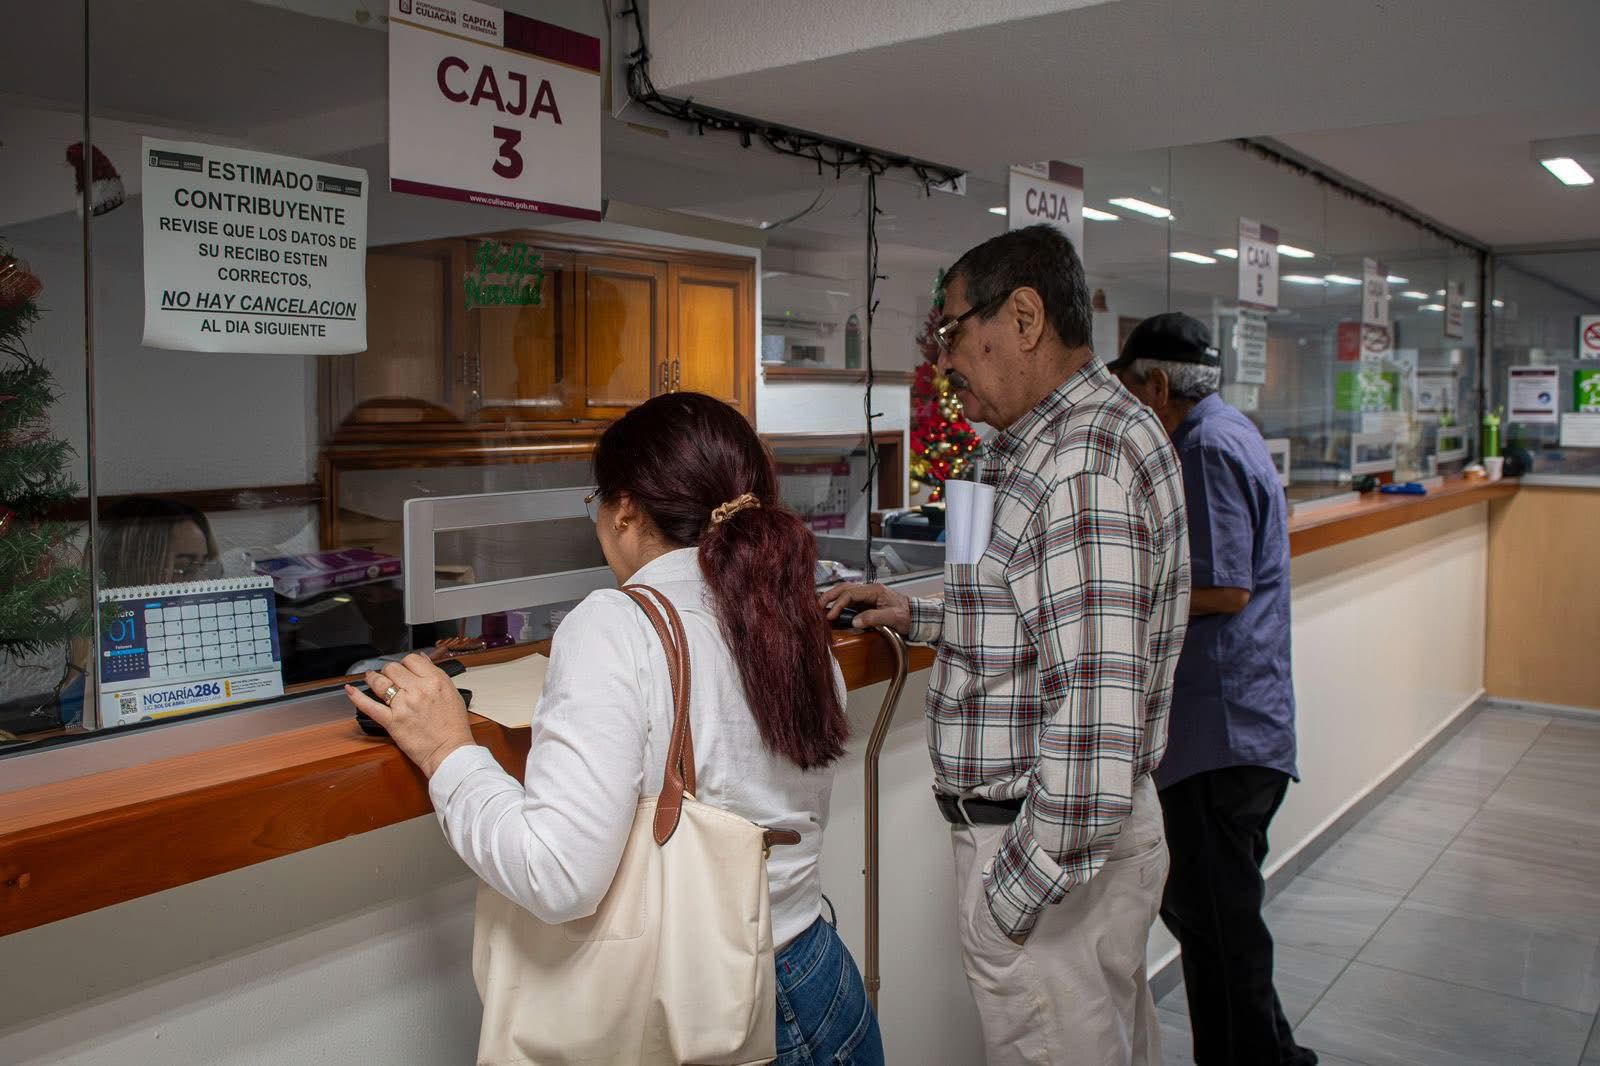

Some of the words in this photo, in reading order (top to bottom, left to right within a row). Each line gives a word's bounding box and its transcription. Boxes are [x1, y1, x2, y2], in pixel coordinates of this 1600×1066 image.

[463, 14, 497, 30] CAPITAL
[437, 56, 562, 125] CAJA
[492, 125, 523, 179] 3
[208, 160, 313, 191] ESTIMADO
[175, 188, 345, 225] CONTRIBUYENTE
[470, 195, 538, 211] www.culiacan.gob.mx
[1026, 187, 1070, 224] CAJA
[160, 217, 218, 235] REVISE
[223, 223, 254, 239] QUE
[259, 227, 287, 242] LOS
[291, 231, 336, 247] DATOS
[340, 236, 357, 250] DE
[198, 243, 219, 257] SU
[224, 245, 279, 263] RECIBO
[284, 251, 327, 267] ESTEN
[1248, 245, 1271, 270] CAJA
[218, 267, 312, 289] CORRECTOS,
[161, 290, 190, 308] NO
[196, 292, 236, 310] HAY
[240, 295, 357, 317] CANCELACION
[200, 319, 221, 333] AL
[225, 320, 250, 334] DIA
[254, 321, 326, 337] SIGUIENTE
[109, 618, 136, 642] 01
